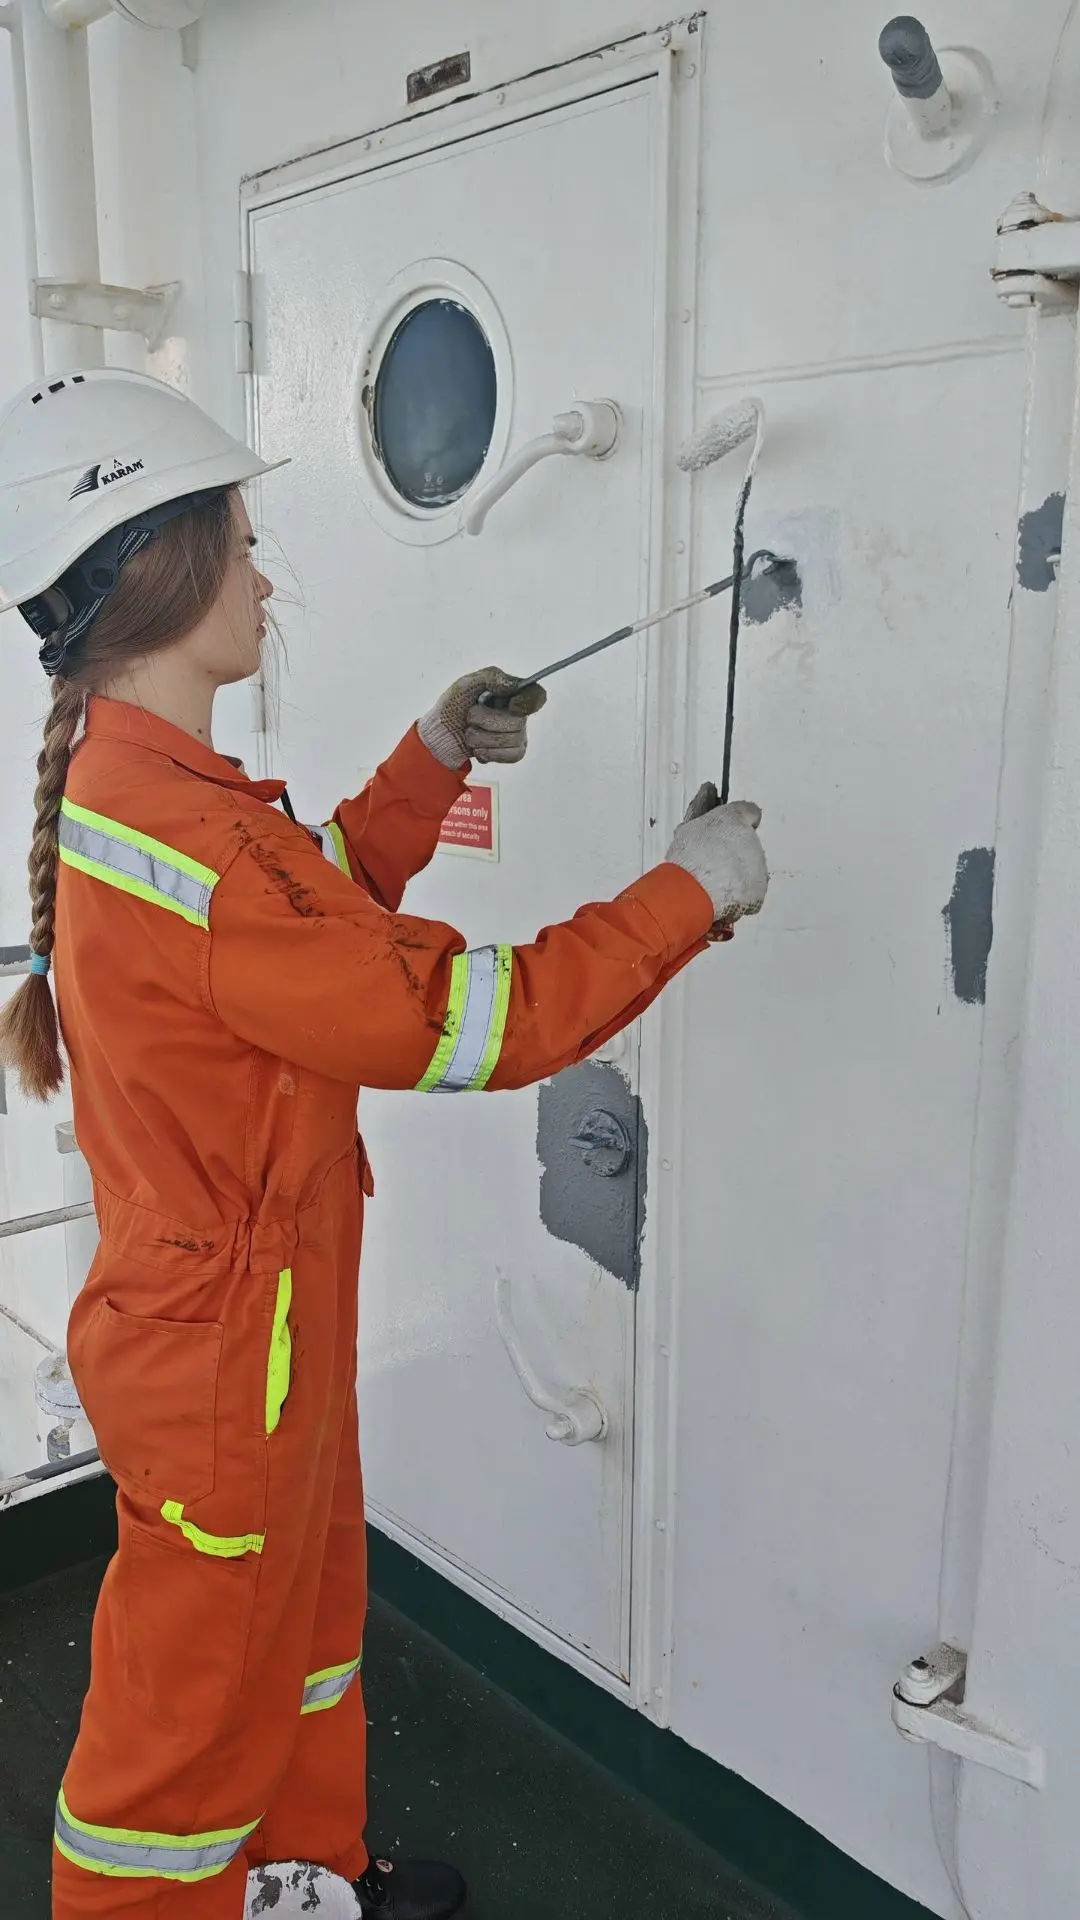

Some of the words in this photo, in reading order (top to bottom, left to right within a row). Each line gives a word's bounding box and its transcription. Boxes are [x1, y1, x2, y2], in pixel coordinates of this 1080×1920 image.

[101, 459, 144, 485] KARAM
[448, 805, 471, 816] rsons
[472, 807, 488, 821] only
[462, 832, 480, 842] security
